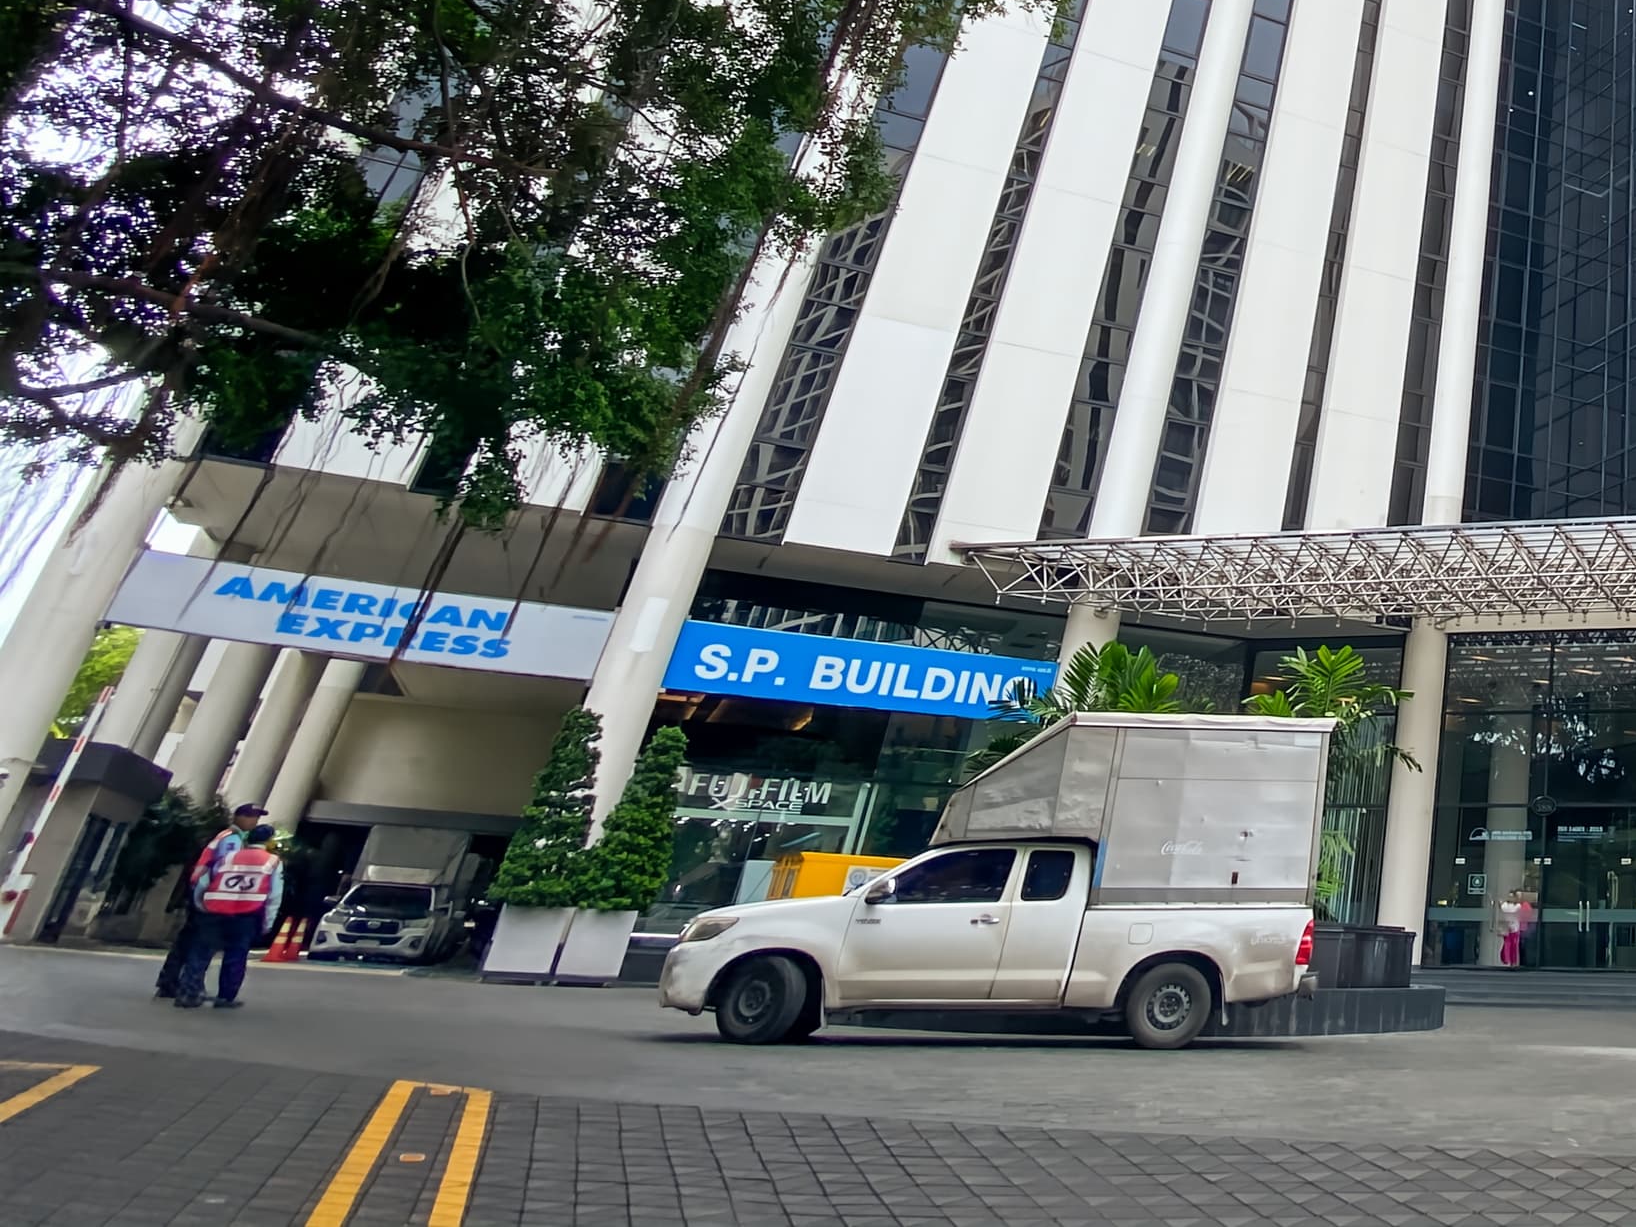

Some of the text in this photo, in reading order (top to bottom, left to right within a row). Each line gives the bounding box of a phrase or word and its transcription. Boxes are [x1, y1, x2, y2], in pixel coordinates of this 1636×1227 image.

[694, 644, 785, 686] S.P.
[687, 773, 832, 804] FUJIFILM
[735, 798, 804, 811] SPACE
